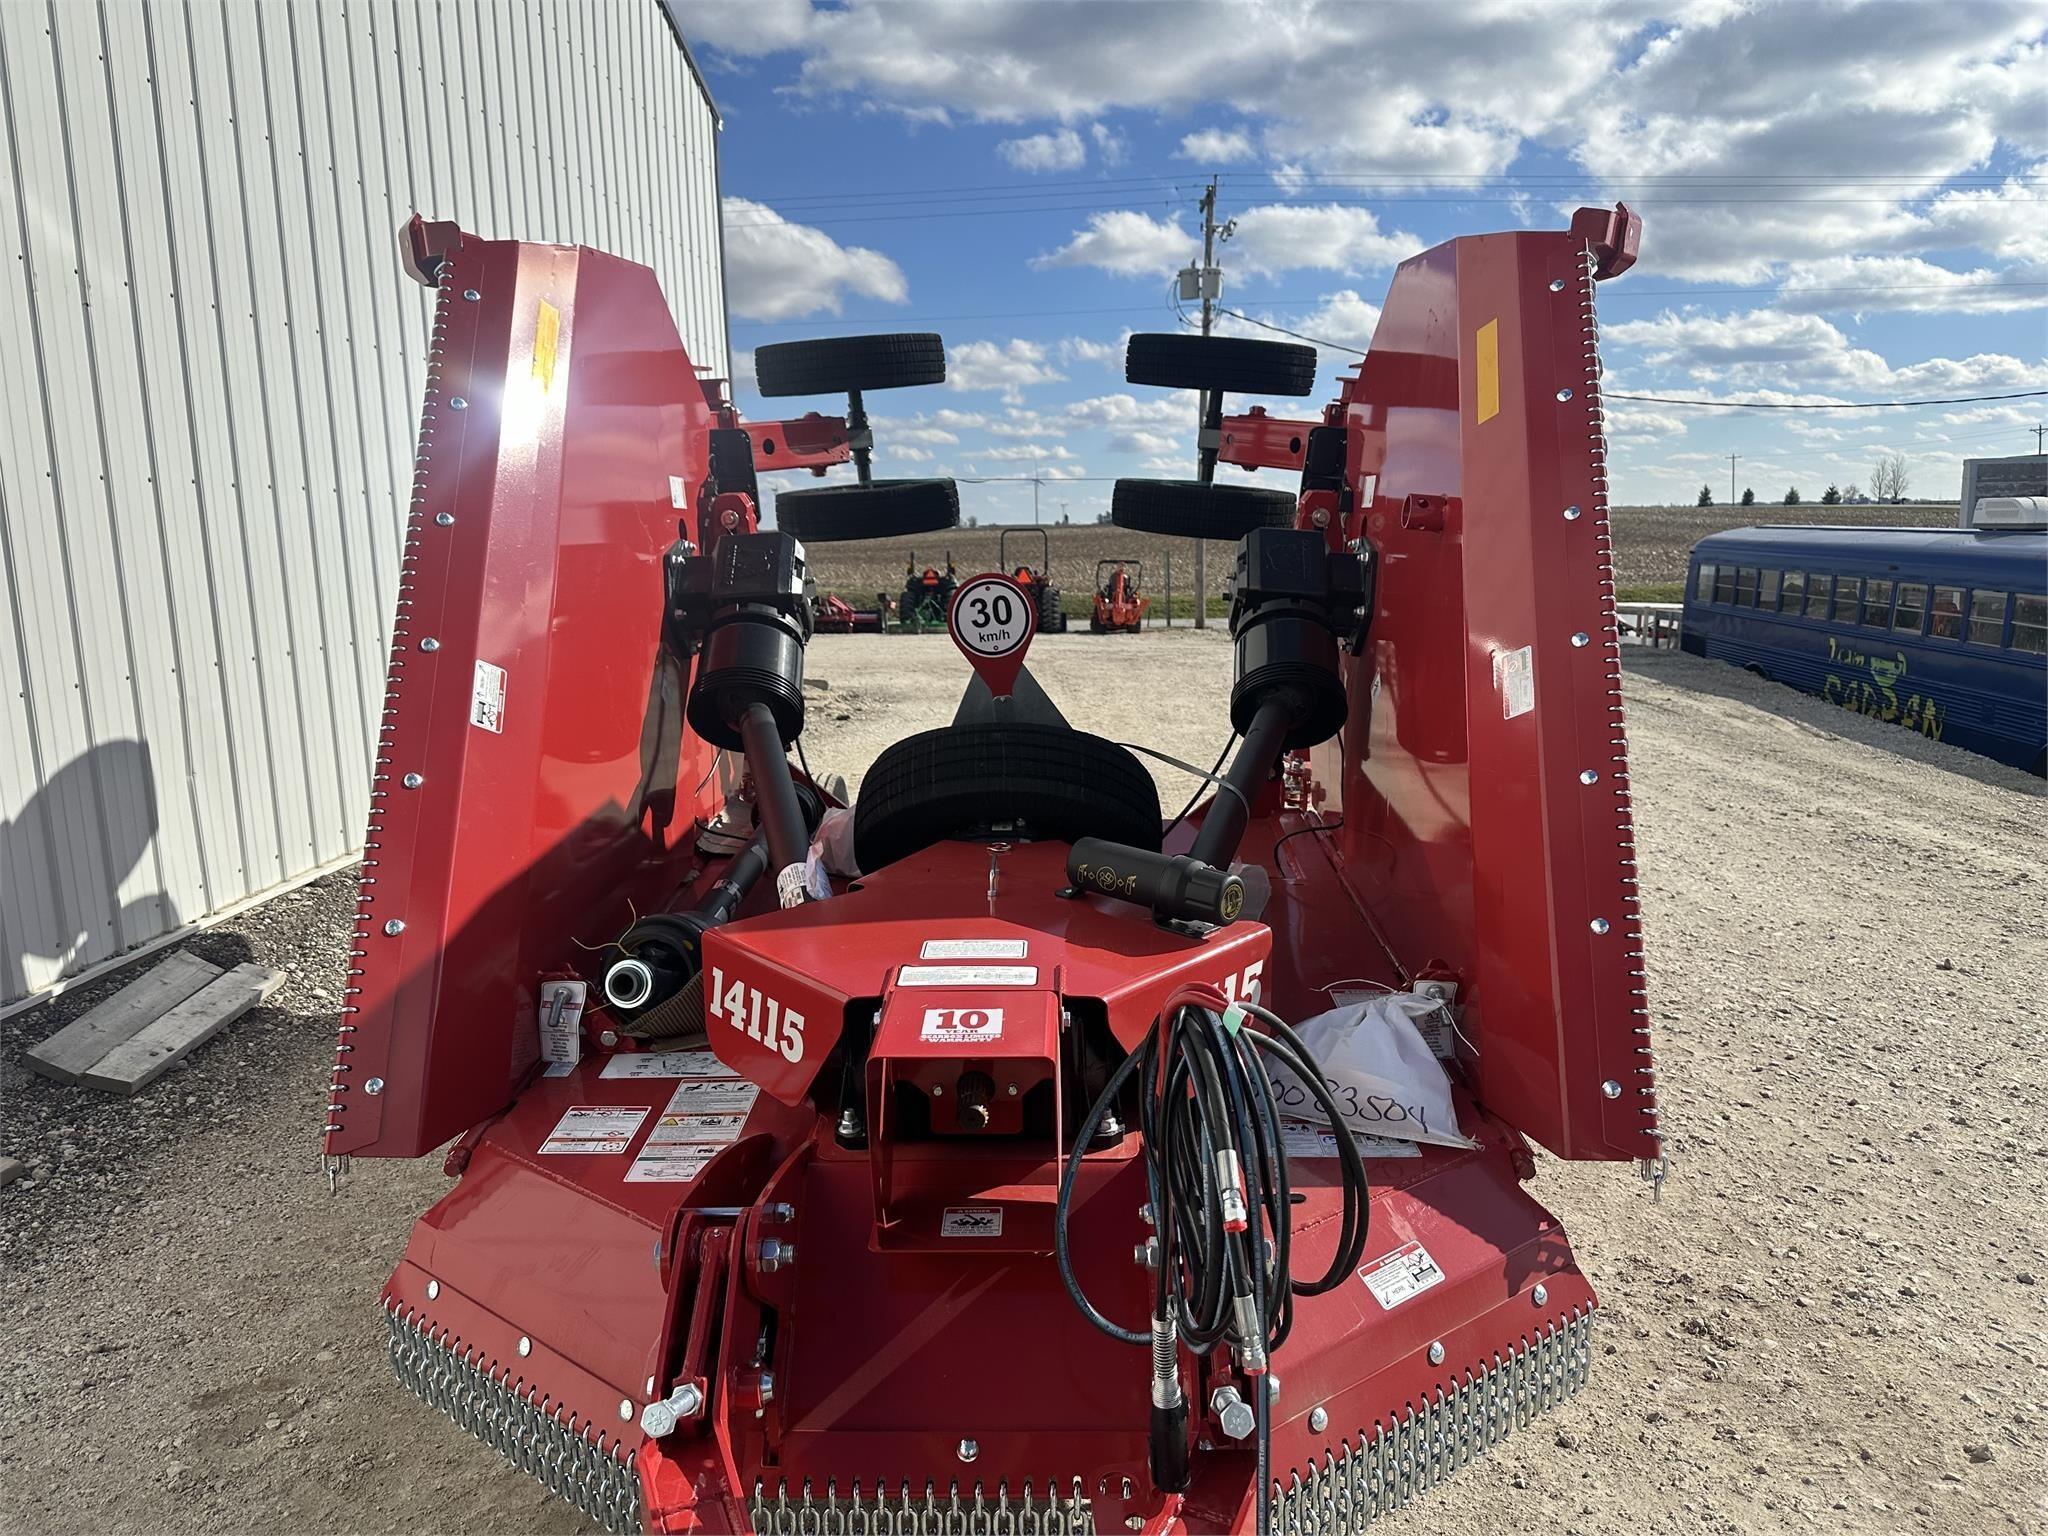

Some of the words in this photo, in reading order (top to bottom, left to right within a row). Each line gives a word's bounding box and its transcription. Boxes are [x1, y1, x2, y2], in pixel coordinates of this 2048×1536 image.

[969, 595, 1012, 628] 30
[978, 629, 1010, 643] km/h
[1211, 959, 1264, 1006] 15
[709, 966, 805, 1064] 14115
[936, 1010, 989, 1029] 10
